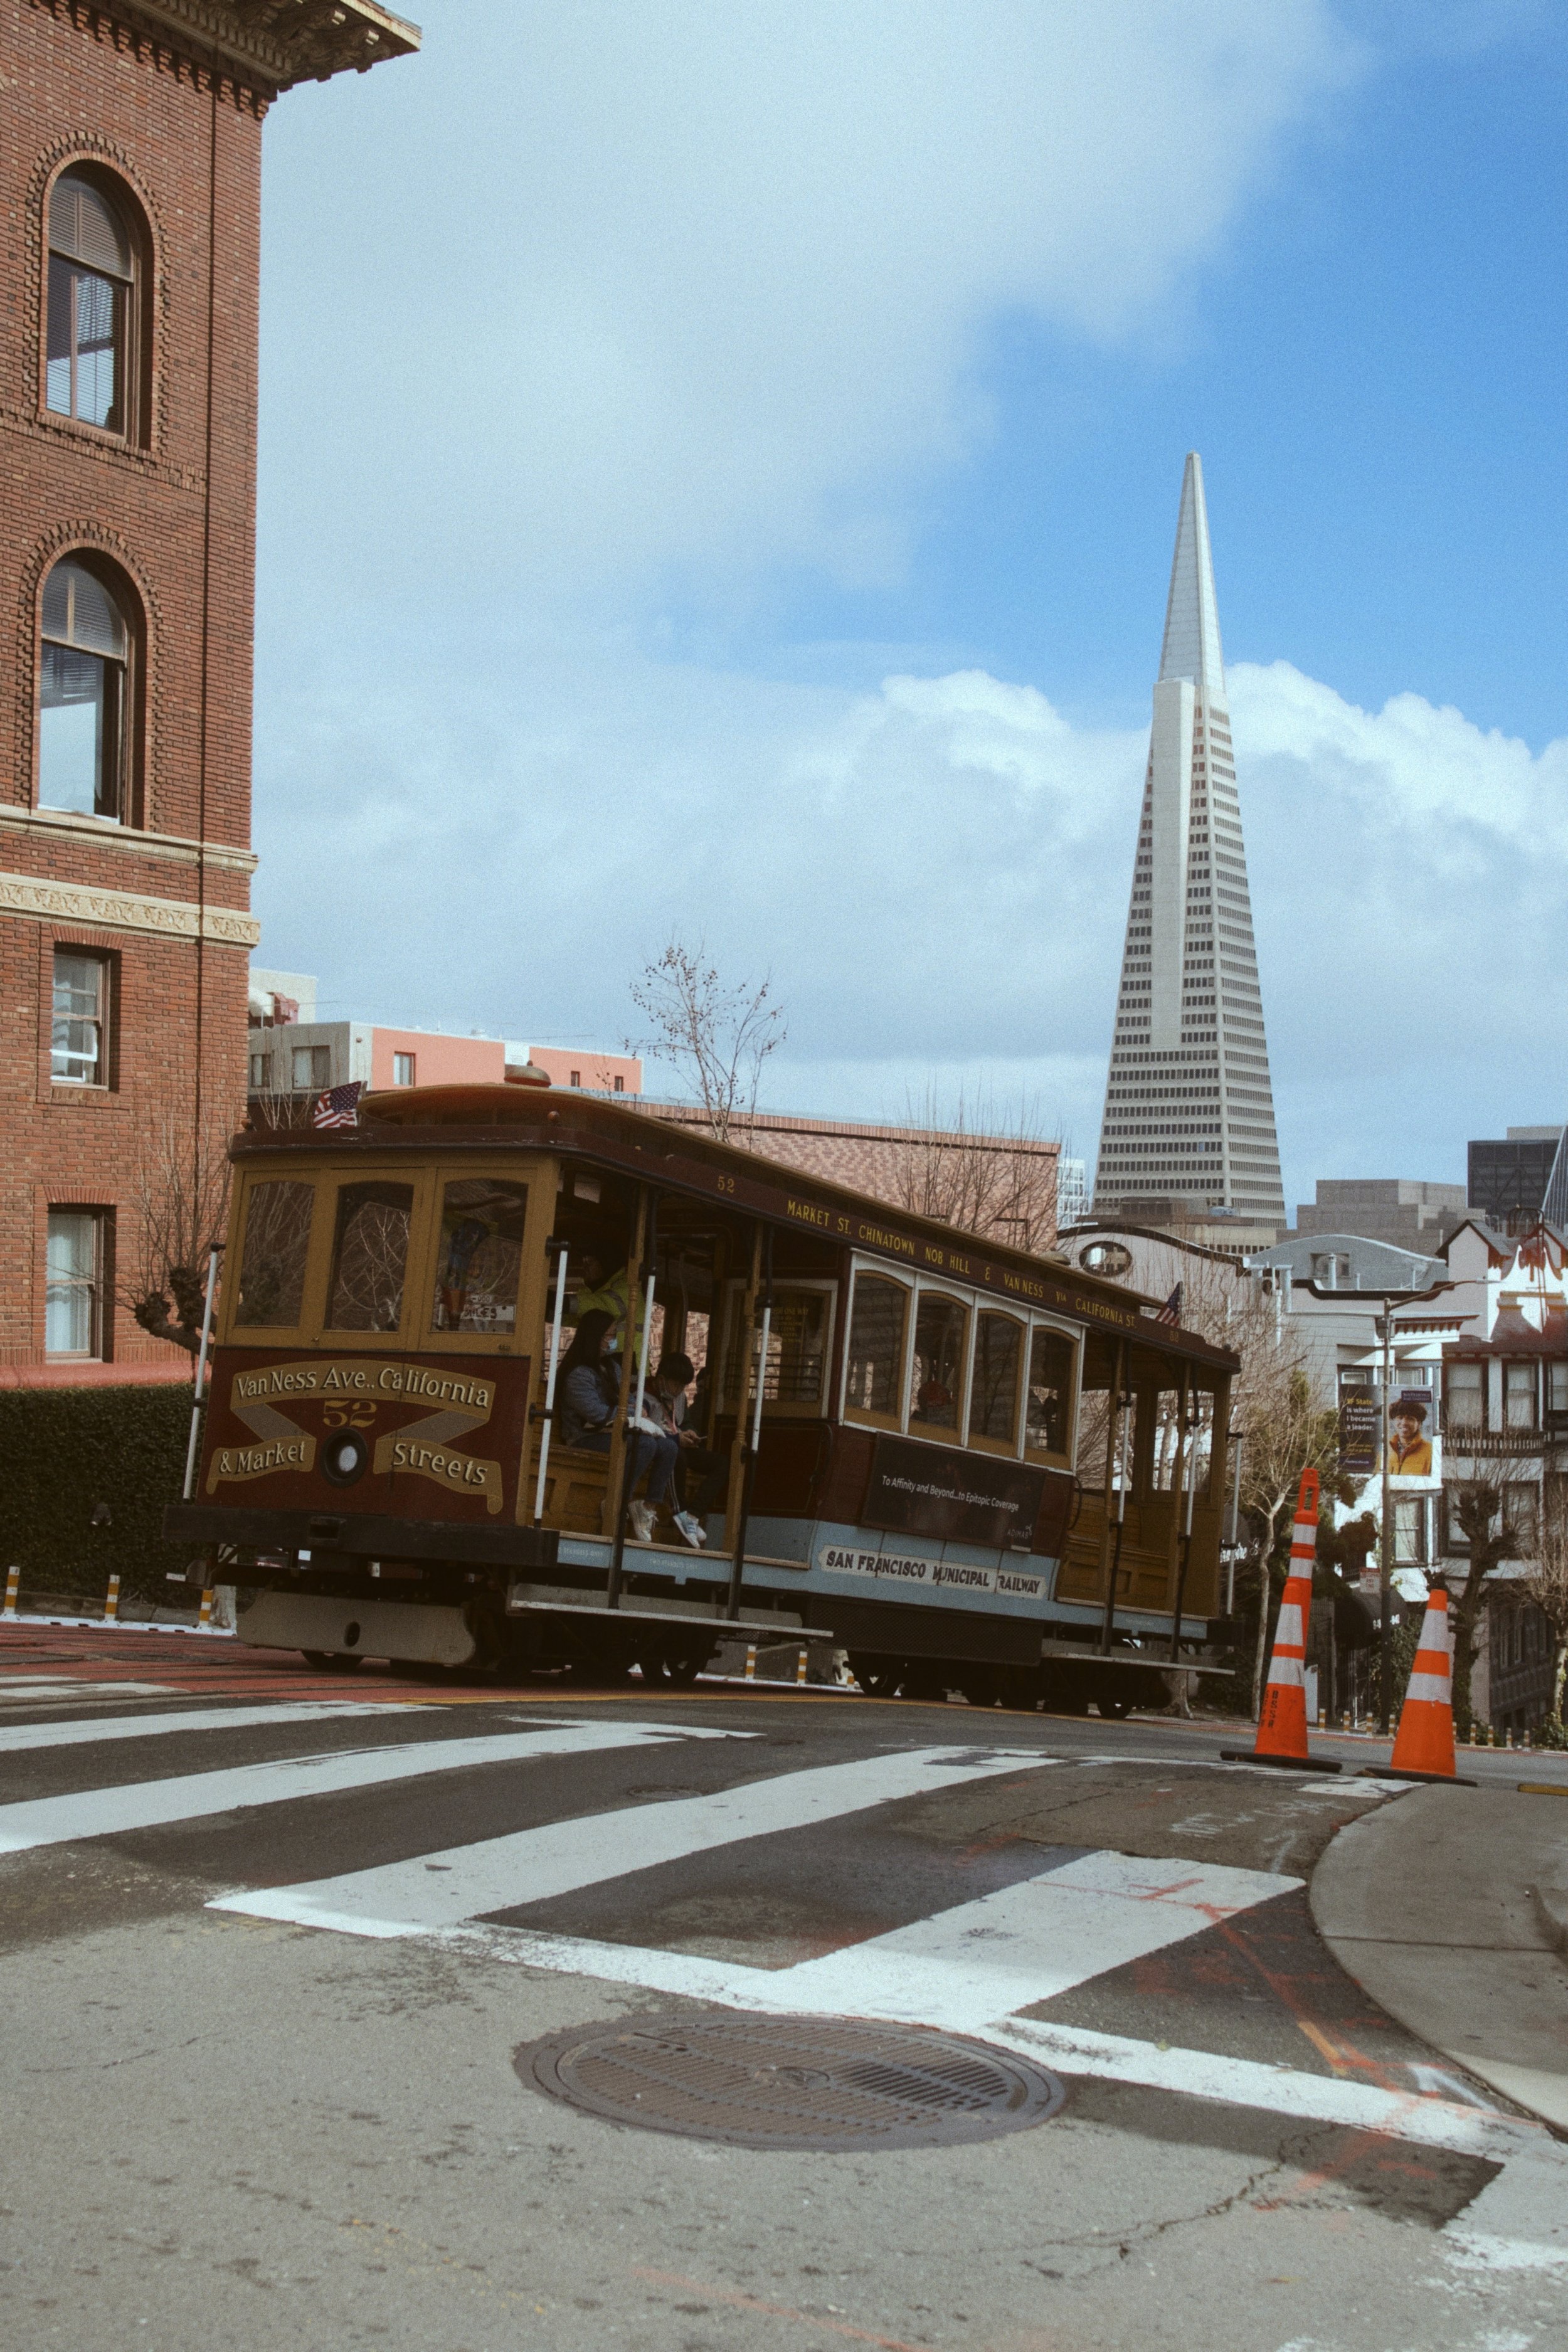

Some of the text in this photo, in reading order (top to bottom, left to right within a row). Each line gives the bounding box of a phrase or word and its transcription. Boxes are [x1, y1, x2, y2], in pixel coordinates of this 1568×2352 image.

[718, 1176, 734, 1193] 52
[787, 1199, 830, 1227] MARKET
[859, 1224, 914, 1256] CHINATOWN
[925, 1246, 943, 1265] NOB
[950, 1255, 970, 1274] HILL
[1004, 1273, 1020, 1290] VAN
[1022, 1279, 1044, 1298] NESS
[1056, 1291, 1067, 1303] VIA
[1075, 1298, 1123, 1325] CALIFORNIA
[1168, 1330, 1179, 1343] 52
[238, 1376, 268, 1399] Van
[270, 1370, 317, 1392] Ness
[379, 1368, 489, 1408] California
[322, 1400, 376, 1428] 52
[218, 1442, 305, 1473] & Market
[393, 1443, 488, 1486] Streets
[882, 1475, 891, 1486] To
[891, 1478, 916, 1493] Affinity
[916, 1483, 930, 1494] and
[966, 1491, 991, 1507] Epitopic
[991, 1497, 1020, 1513] Coverage
[826, 1550, 1041, 1594] SAN FRANCISCO MUNICIPAL RAILWAY
